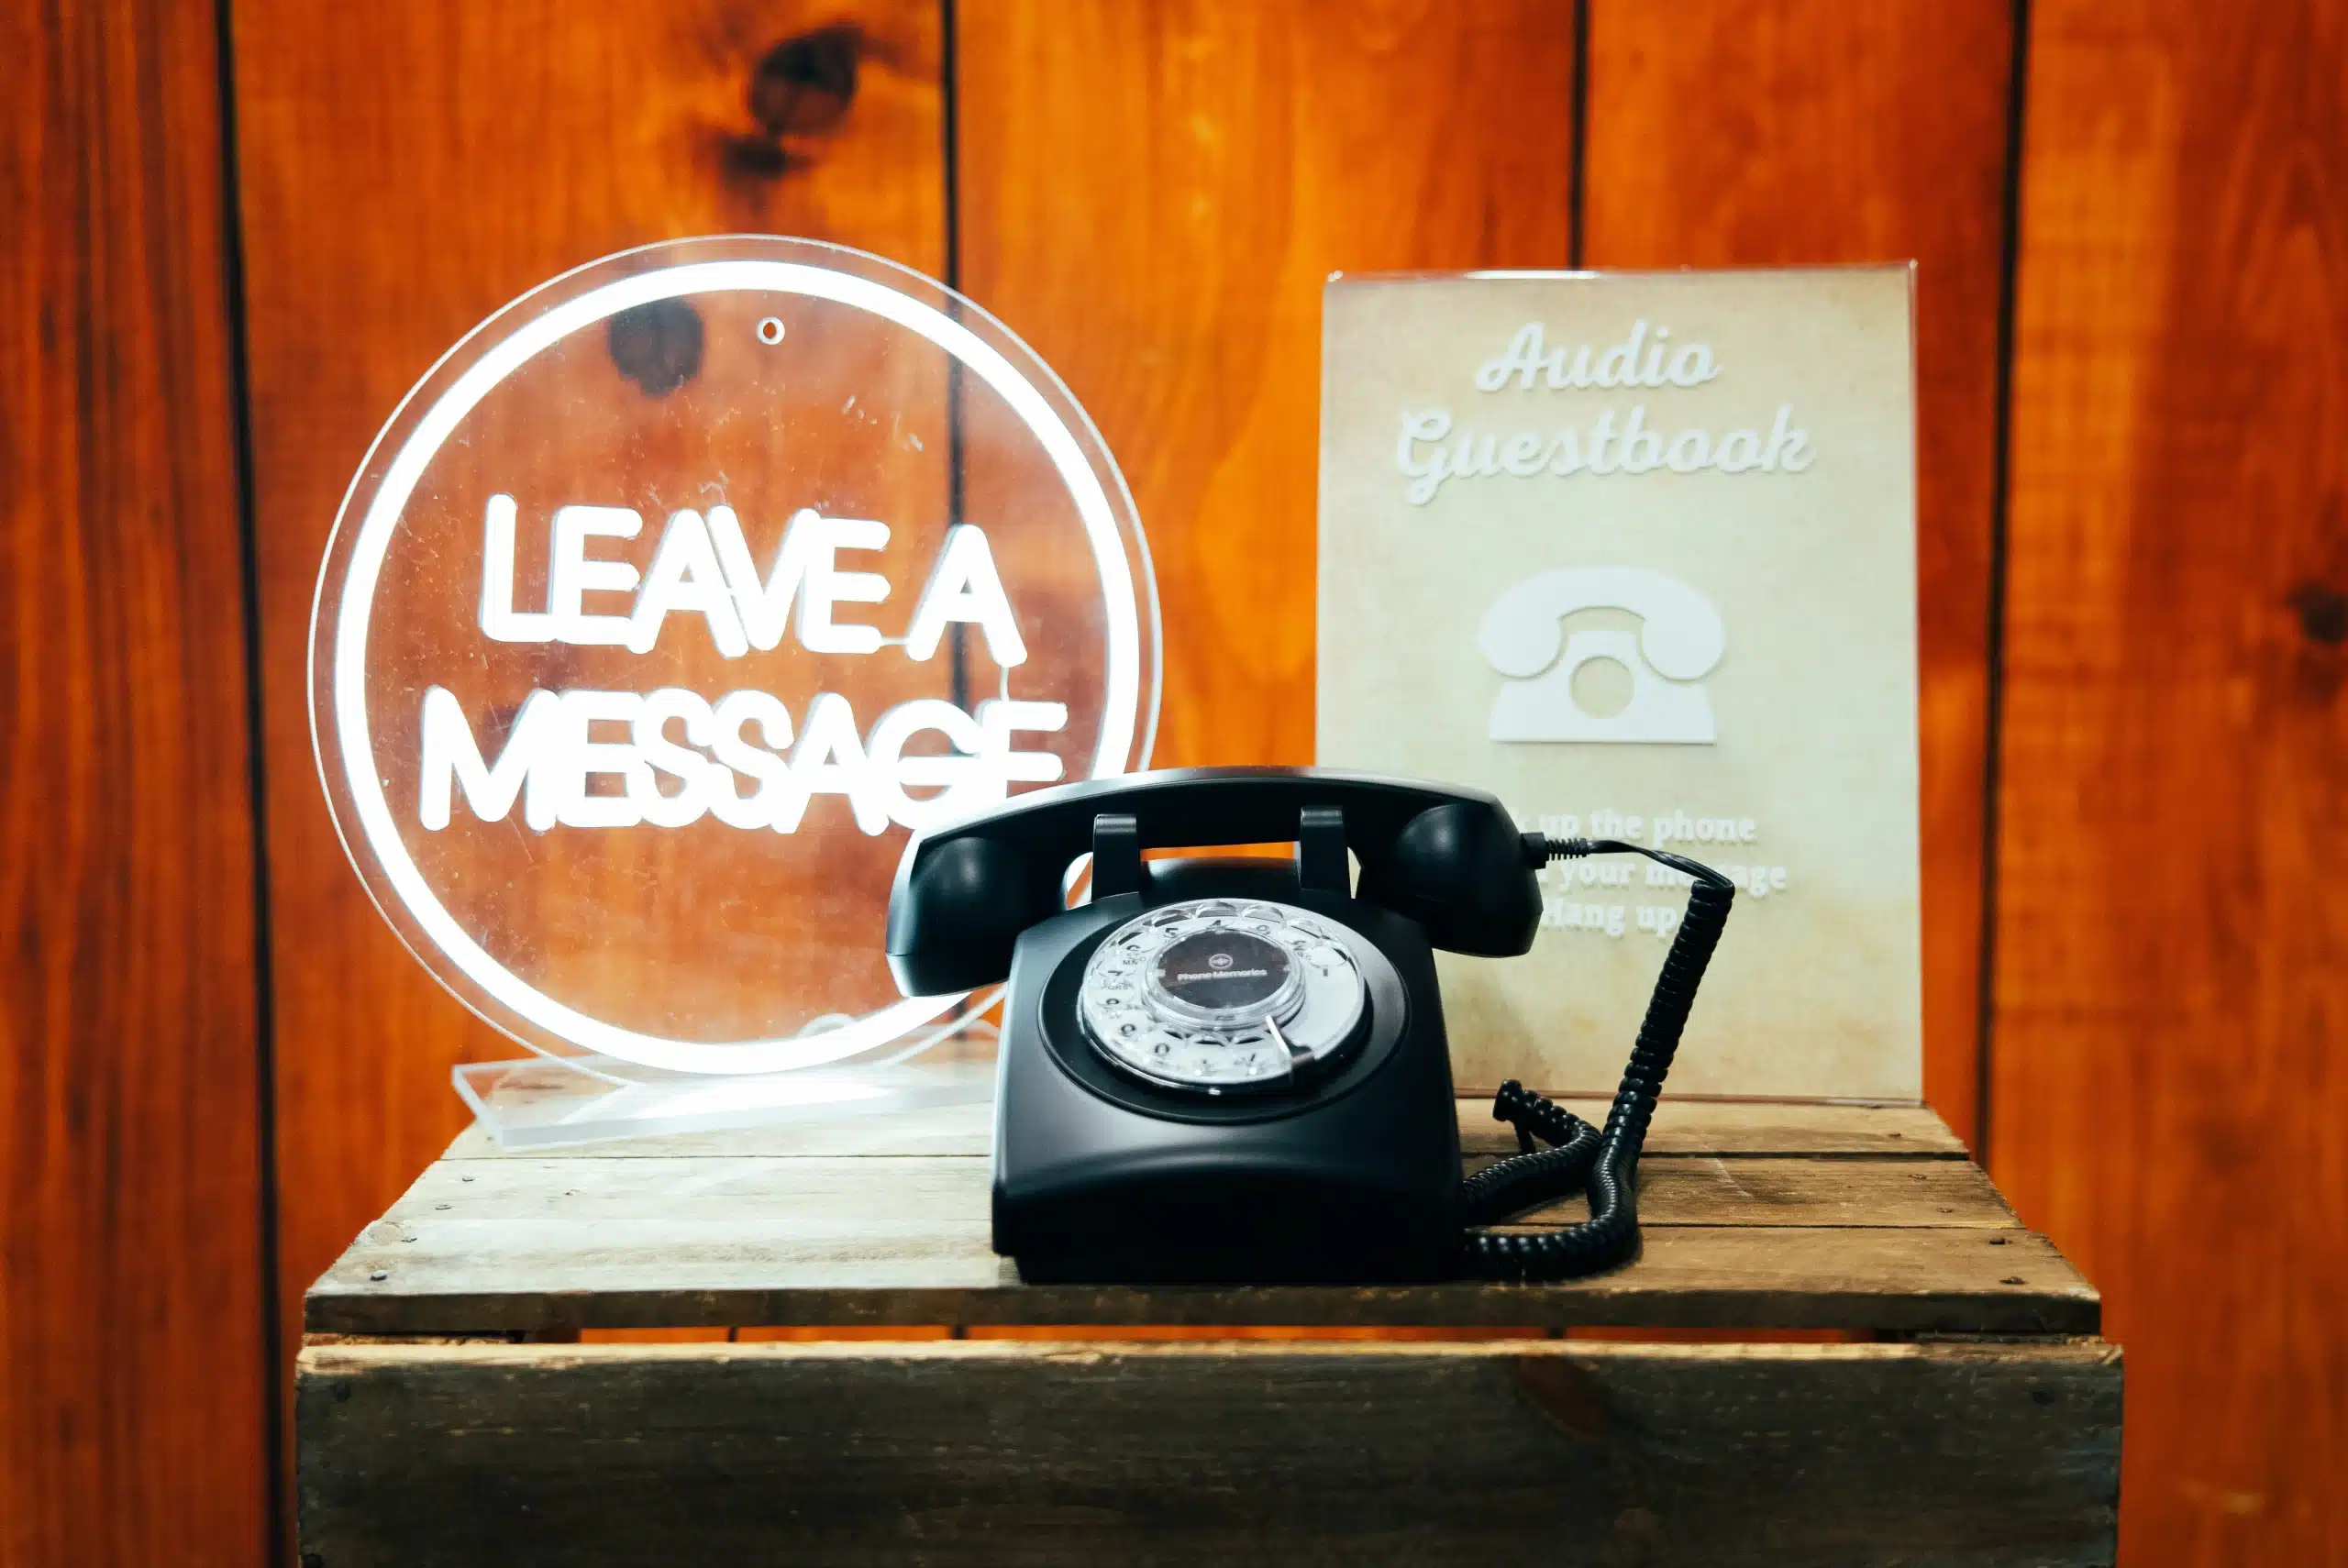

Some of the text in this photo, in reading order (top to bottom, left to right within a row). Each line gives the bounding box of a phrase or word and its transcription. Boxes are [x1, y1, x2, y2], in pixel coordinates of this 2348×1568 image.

[1474, 318, 1724, 393] Audio
[1396, 402, 1819, 506] Guestbook
[478, 491, 1028, 668] LEAVE A
[1538, 812, 1581, 842] up
[1591, 808, 1645, 841] the
[1652, 808, 1759, 849] phone
[1559, 857, 1637, 893] your
[1636, 903, 1678, 938] up
[1177, 968, 1268, 982] Phone Memories
